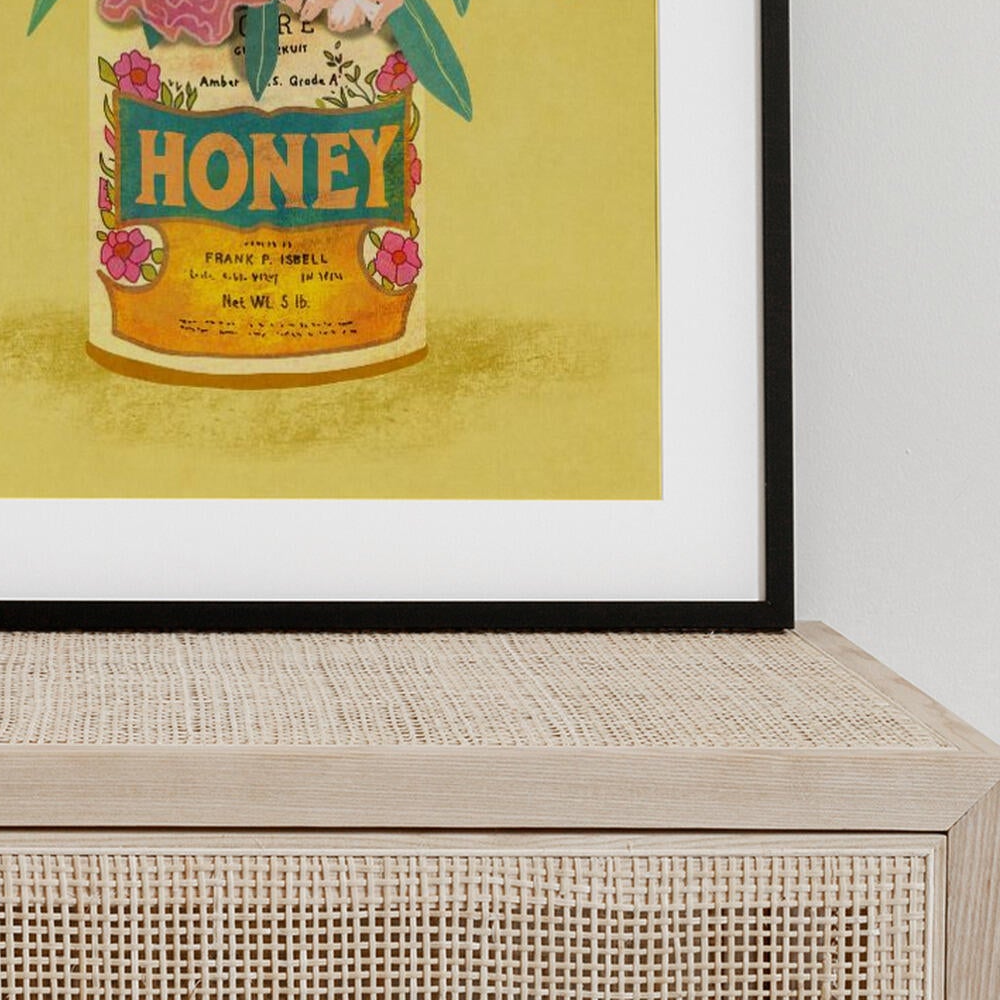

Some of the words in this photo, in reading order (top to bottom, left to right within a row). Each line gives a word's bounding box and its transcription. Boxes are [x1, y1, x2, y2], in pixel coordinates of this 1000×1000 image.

[200, 76, 239, 87] Amber
[289, 75, 325, 87] Grade
[136, 124, 401, 211] HONEY
[205, 252, 254, 264] FRANK
[280, 254, 328, 265] ISBELL
[222, 294, 246, 308] Net
